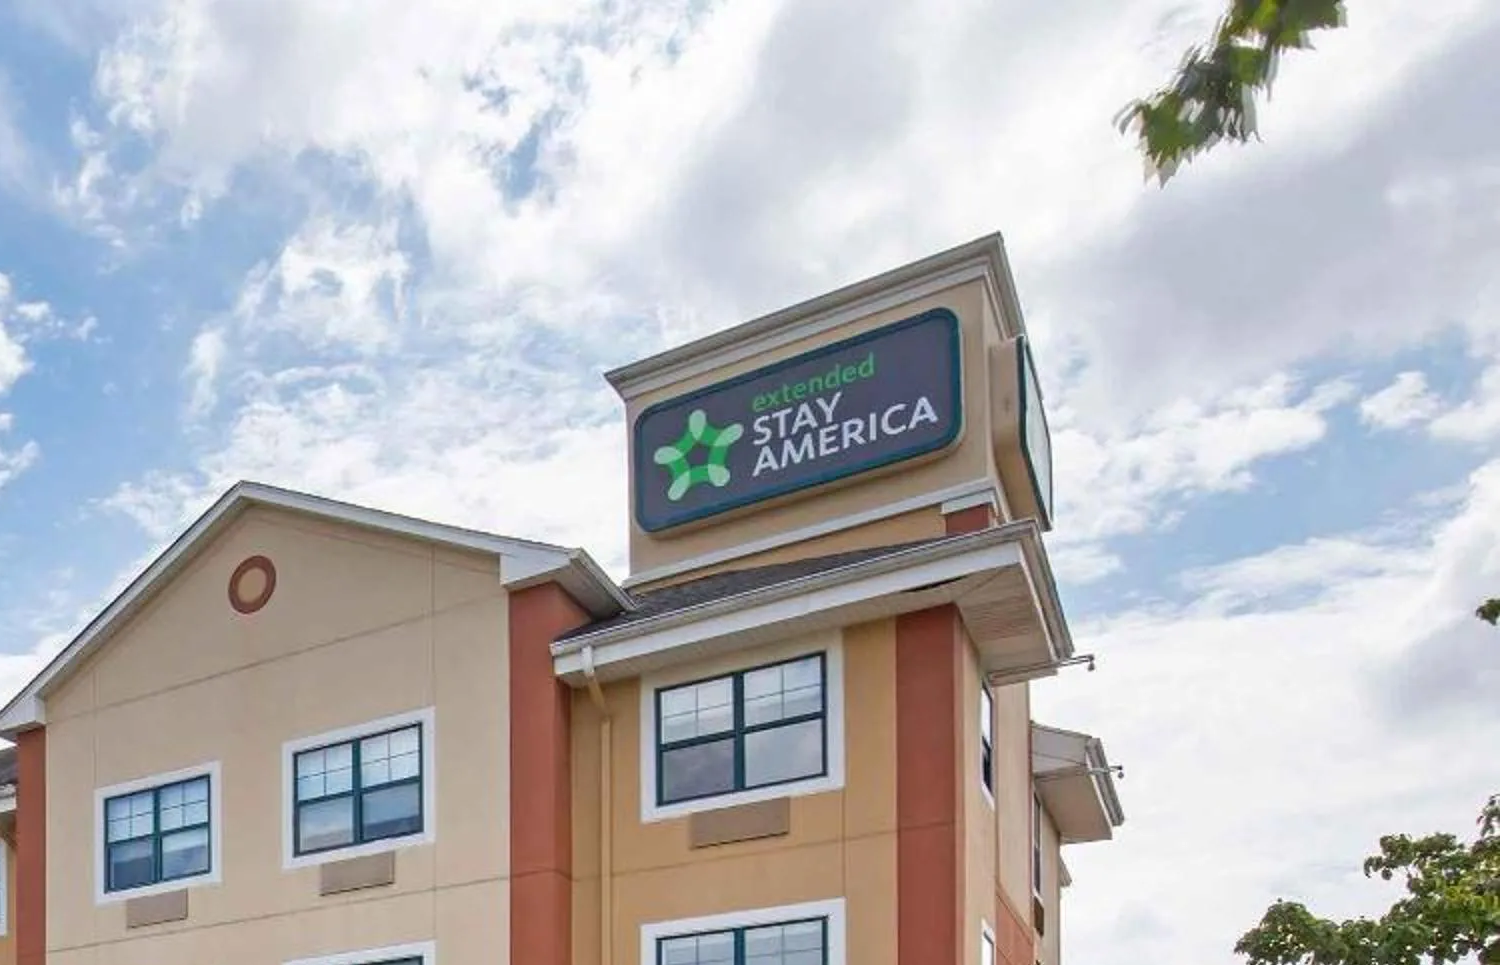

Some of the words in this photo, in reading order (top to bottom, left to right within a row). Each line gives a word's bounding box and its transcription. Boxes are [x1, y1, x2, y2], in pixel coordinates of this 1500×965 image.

[752, 351, 876, 413] extended
[751, 396, 939, 478] AMERICA
[752, 391, 842, 446] STAY
